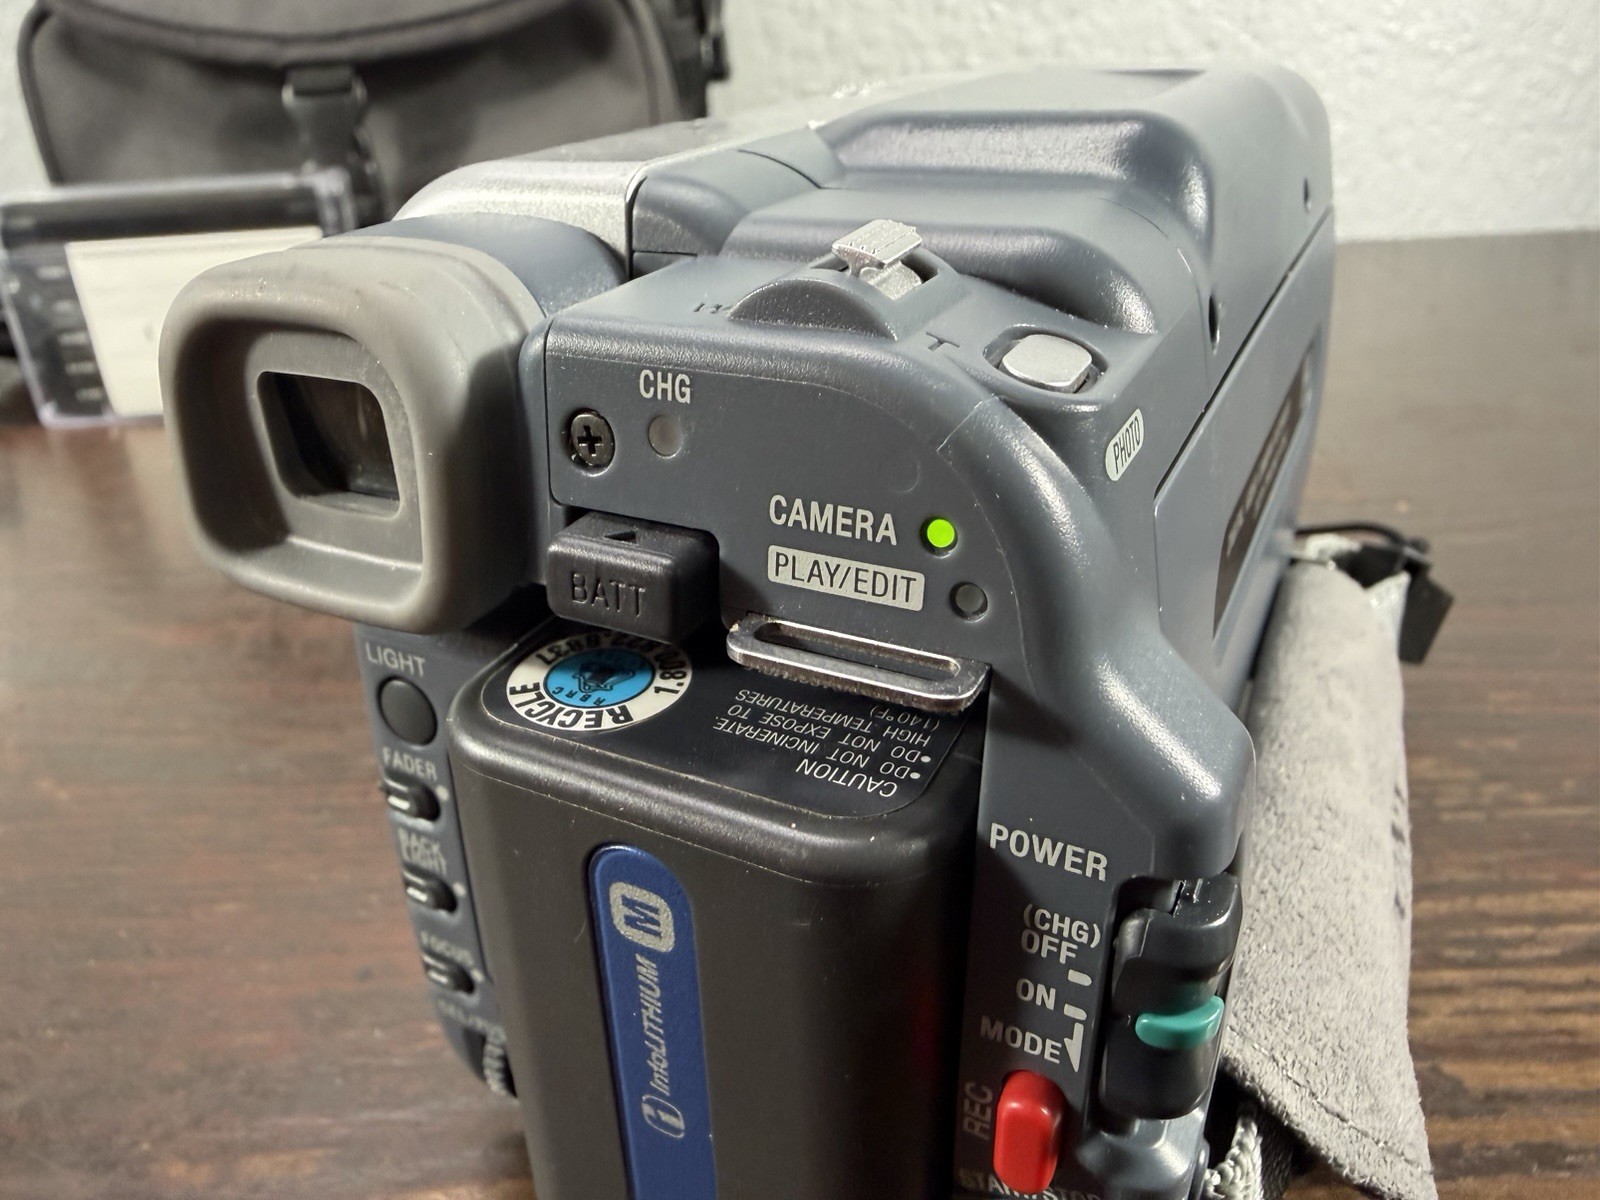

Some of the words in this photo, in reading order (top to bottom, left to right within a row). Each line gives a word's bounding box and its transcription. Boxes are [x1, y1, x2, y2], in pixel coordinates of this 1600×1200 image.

[639, 369, 691, 404] CHG
[1112, 415, 1141, 475] PHOTO
[768, 494, 898, 546] CAMERA
[571, 572, 646, 618] BATT
[774, 551, 917, 603] PLAY/EDIT
[365, 641, 426, 677] LIGHT
[509, 681, 635, 729] RECYCLE
[727, 704, 752, 720] TO
[735, 689, 873, 733] TEMPERATURES
[713, 716, 820, 754] INCINERATE.
[759, 711, 831, 740] EXPOSE
[838, 733, 881, 752] NOT
[883, 726, 932, 748] HIGH
[382, 746, 438, 782] FADER
[825, 748, 870, 768] NOT
[879, 761, 911, 780] DO
[890, 745, 922, 763] DO
[796, 758, 898, 798] CAUTION
[989, 822, 1108, 882] POWER
[1023, 903, 1101, 949] (CHG)
[1021, 929, 1079, 965] OFF
[1015, 978, 1057, 1011] ON
[635, 953, 670, 1097] InfoLITHIUM
[980, 1015, 1062, 1064] MODE
[962, 1081, 994, 1141] REC
